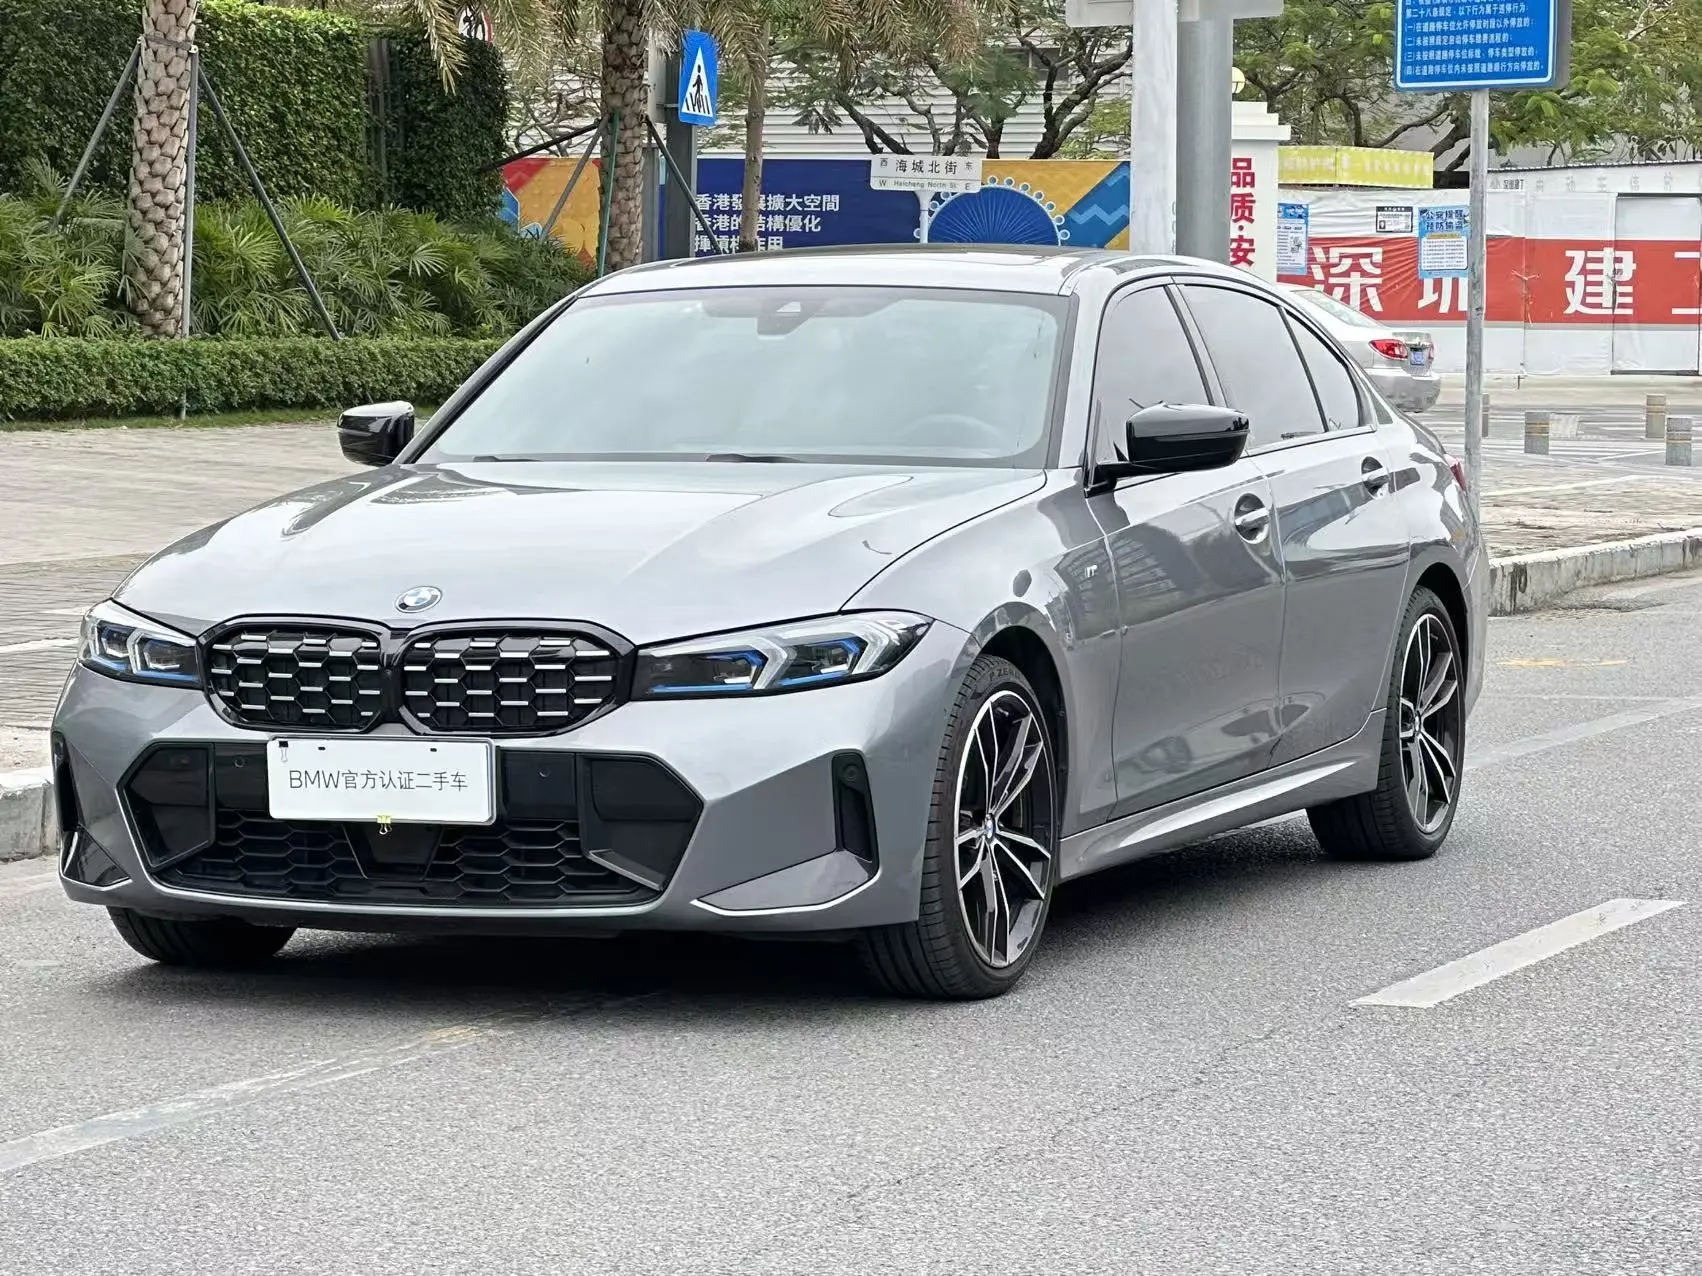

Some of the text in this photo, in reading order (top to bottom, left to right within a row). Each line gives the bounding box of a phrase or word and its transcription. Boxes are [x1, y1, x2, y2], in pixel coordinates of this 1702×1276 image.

[895, 160, 957, 174] 海城北街
[879, 180, 887, 188] W
[965, 182, 971, 190] E
[289, 769, 468, 792] BMW官方认证二手车
